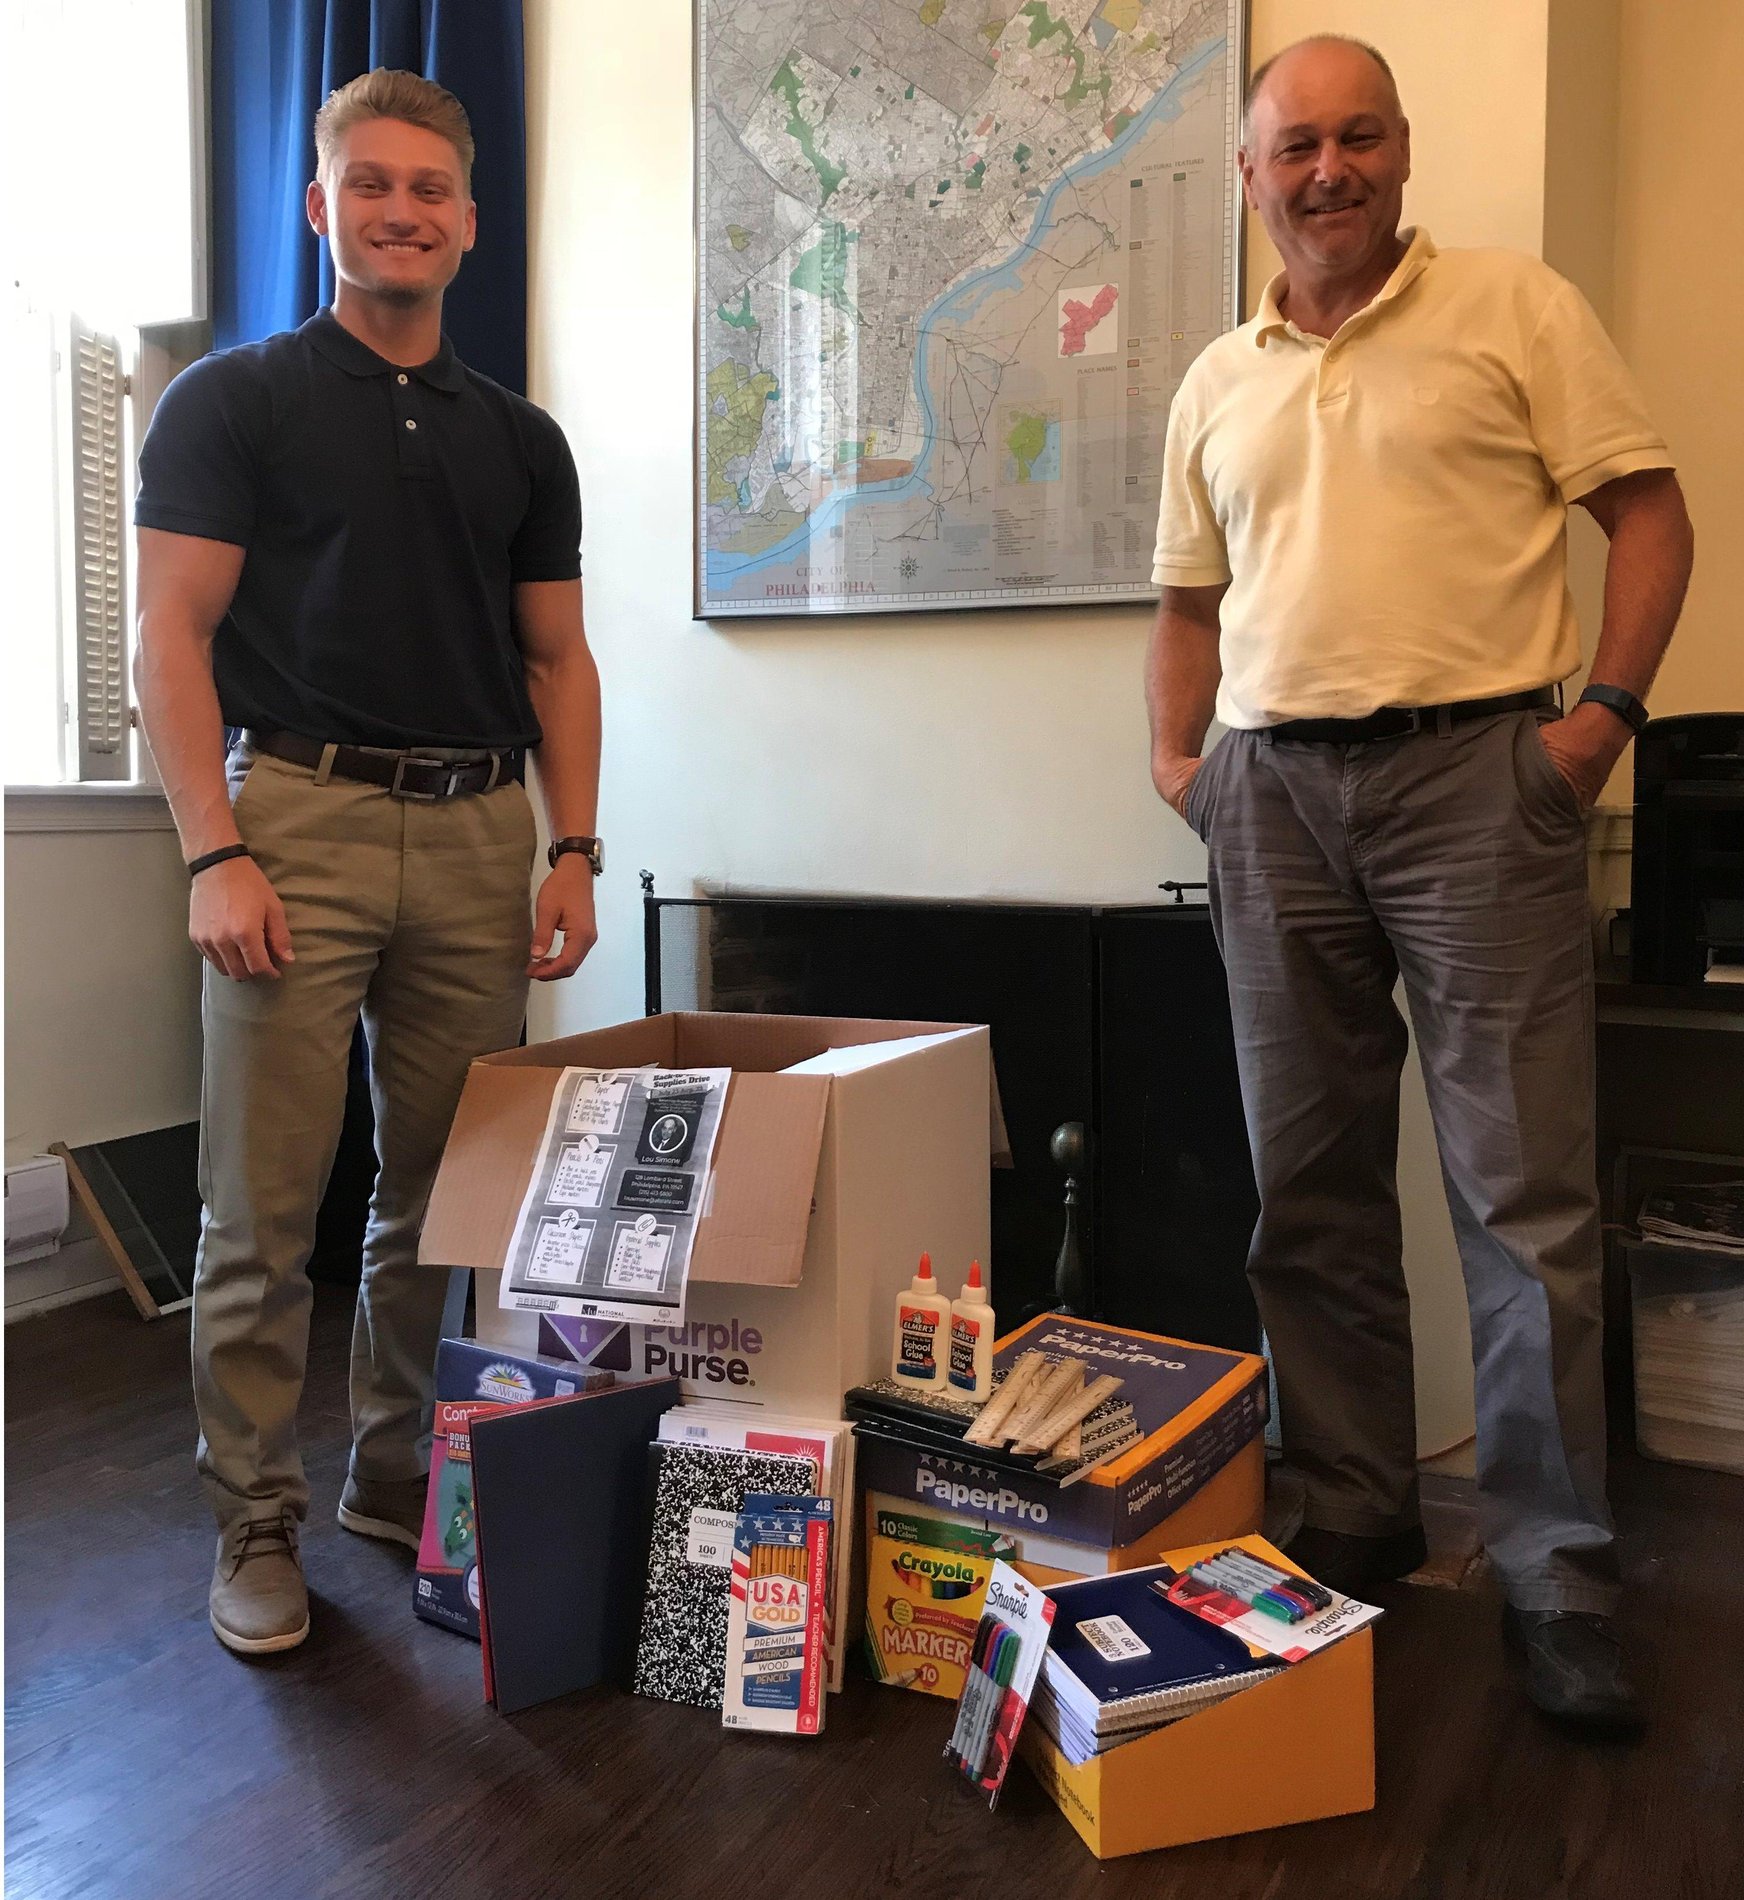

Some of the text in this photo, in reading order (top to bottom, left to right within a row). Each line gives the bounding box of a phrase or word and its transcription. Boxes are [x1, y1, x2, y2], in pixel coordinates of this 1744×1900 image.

[1174, 158, 1205, 168] FEATURES
[796, 566, 823, 578] CITY
[766, 580, 876, 597] PHILADELPHIA
[653, 1075, 711, 1088] Supplies Drive
[641, 1155, 654, 1163] Lou
[903, 1321, 934, 1333] ELMER'S
[903, 1339, 931, 1352] School
[1038, 1333, 1187, 1370] PaperPro
[905, 1349, 924, 1360] Glue
[951, 1347, 972, 1363] School
[952, 1357, 966, 1370] Glue
[449, 1432, 470, 1443] BONU
[915, 1467, 1049, 1524] PaperPro
[1127, 1483, 1162, 1516] PaperPro
[815, 1499, 831, 1512] 48
[880, 1518, 897, 1536] 10
[897, 1522, 919, 1533] Classic
[897, 1530, 918, 1541] Colors
[698, 1543, 717, 1556] 100
[898, 1551, 975, 1582] Crayola
[753, 1581, 801, 1606] USA
[985, 1581, 1029, 1619] Sharpie
[752, 1605, 801, 1623] GOLD
[809, 1525, 825, 1706] AMERICA'S PENCIL TEACHER RECOMMENDED
[942, 1614, 949, 1625] by
[1305, 1598, 1364, 1636] Sharpie
[754, 1635, 796, 1648] PREMIUM
[1080, 1622, 1113, 1654] SUBJECT
[1088, 1621, 1126, 1657] NOTEBOOK
[1120, 1637, 1140, 1652] 120
[752, 1646, 798, 1661] AMERICAN
[883, 1626, 972, 1668] MARKER
[758, 1660, 789, 1672] WOOD
[755, 1672, 791, 1685] PENCILS
[921, 1665, 938, 1683] 10
[724, 1715, 738, 1725] 48
